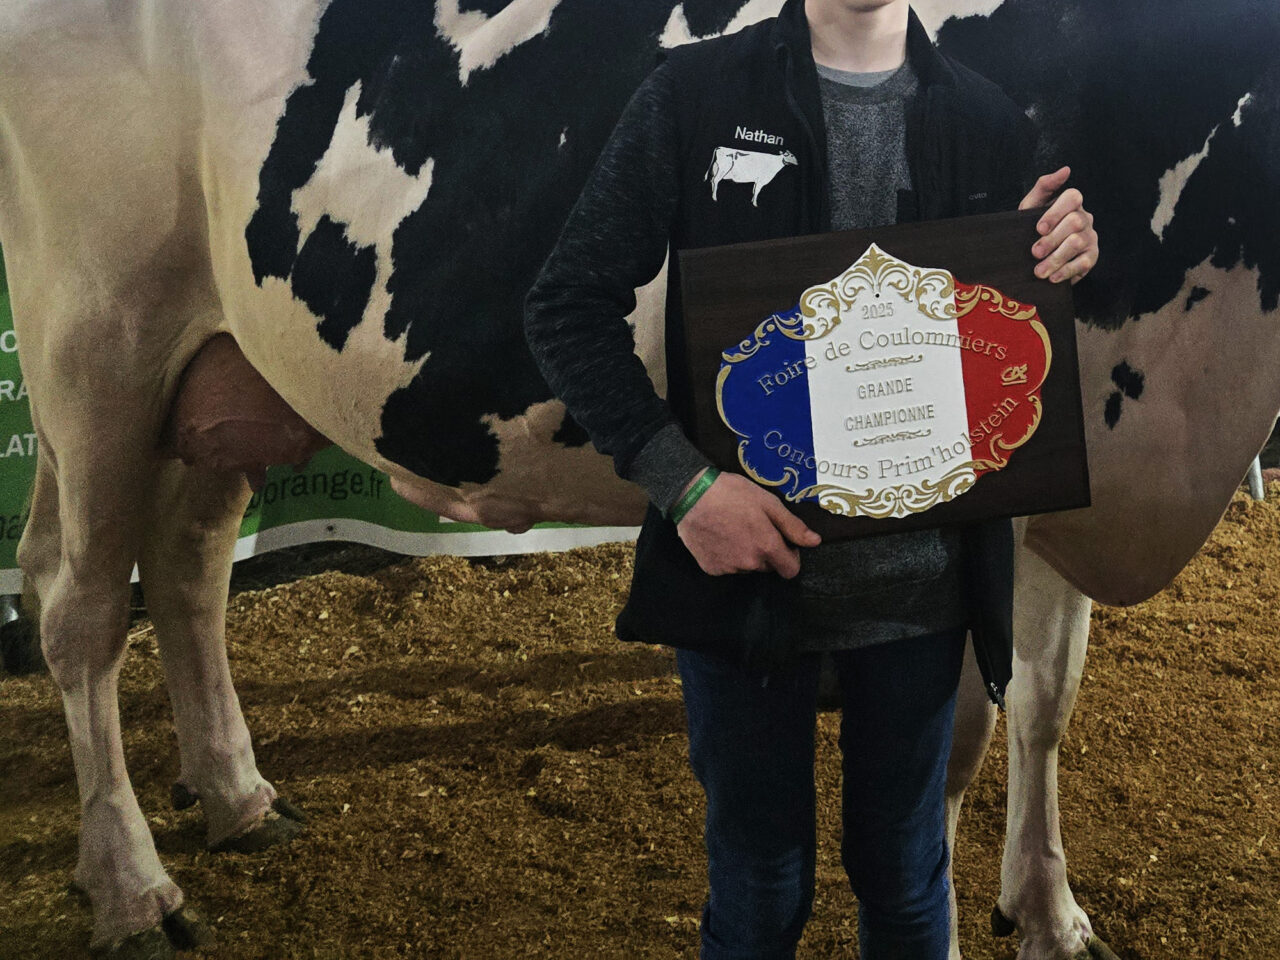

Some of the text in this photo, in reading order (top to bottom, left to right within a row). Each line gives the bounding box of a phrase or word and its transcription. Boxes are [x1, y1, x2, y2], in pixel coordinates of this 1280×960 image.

[734, 125, 784, 146] Nathan
[861, 302, 894, 320] 2025
[757, 327, 1008, 396] Foire de Coulommiers
[858, 377, 914, 400] GRANDE
[844, 404, 936, 433] CHAMPIONNE
[763, 394, 1020, 480] Concours Prim'holstein
